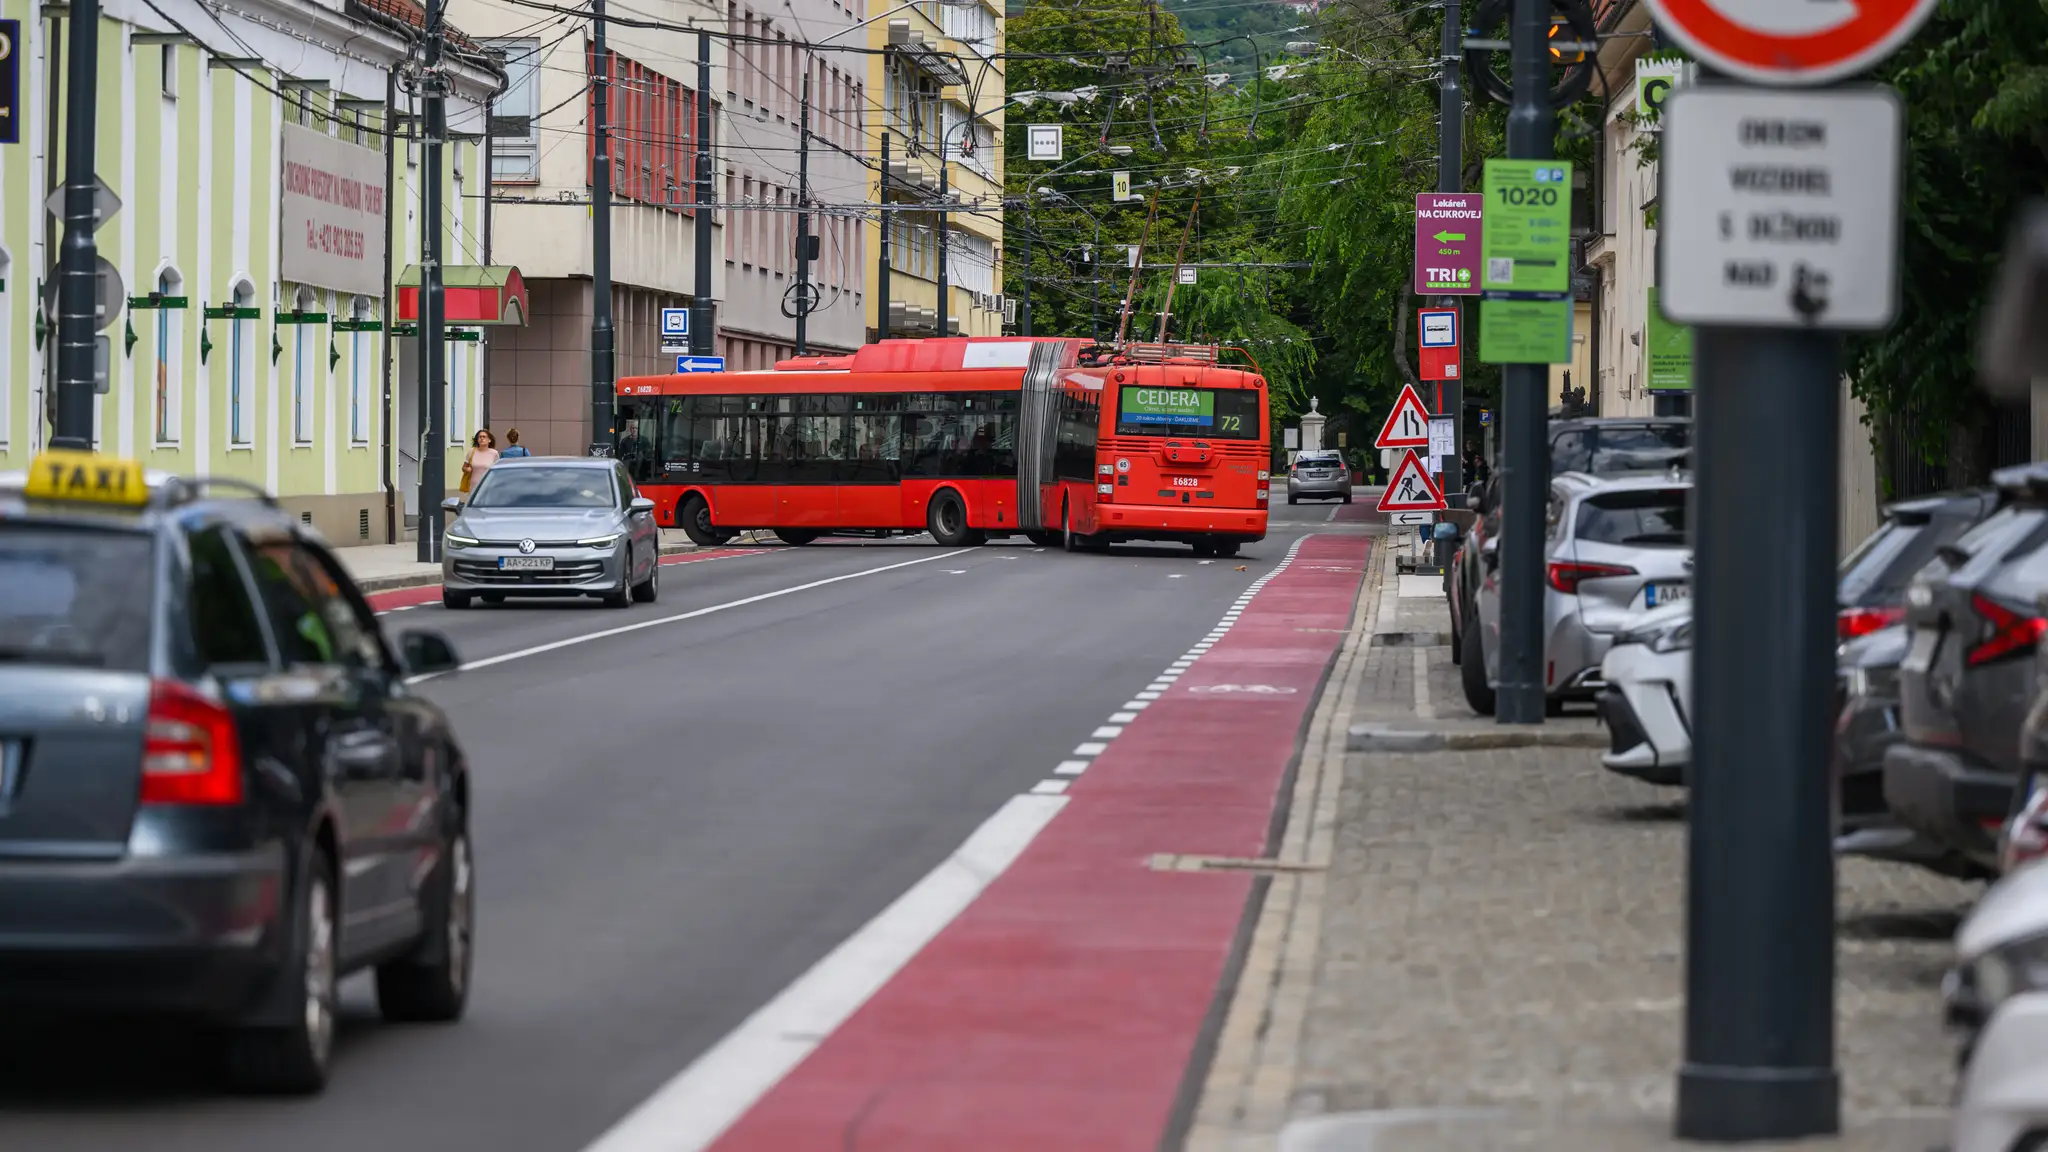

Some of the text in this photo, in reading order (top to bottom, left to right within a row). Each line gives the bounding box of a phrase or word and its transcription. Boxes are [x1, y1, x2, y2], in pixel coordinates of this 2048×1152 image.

[1117, 181, 1127, 193] 10
[1433, 199, 1467, 208] Lekáreň
[1497, 187, 1557, 206] 1020
[1418, 210, 1482, 219] NA CUKROVEJ
[1136, 389, 1200, 407] CEDERA
[671, 400, 682, 413] 72
[1221, 416, 1240, 431] 72
[49, 463, 128, 492] TAXI
